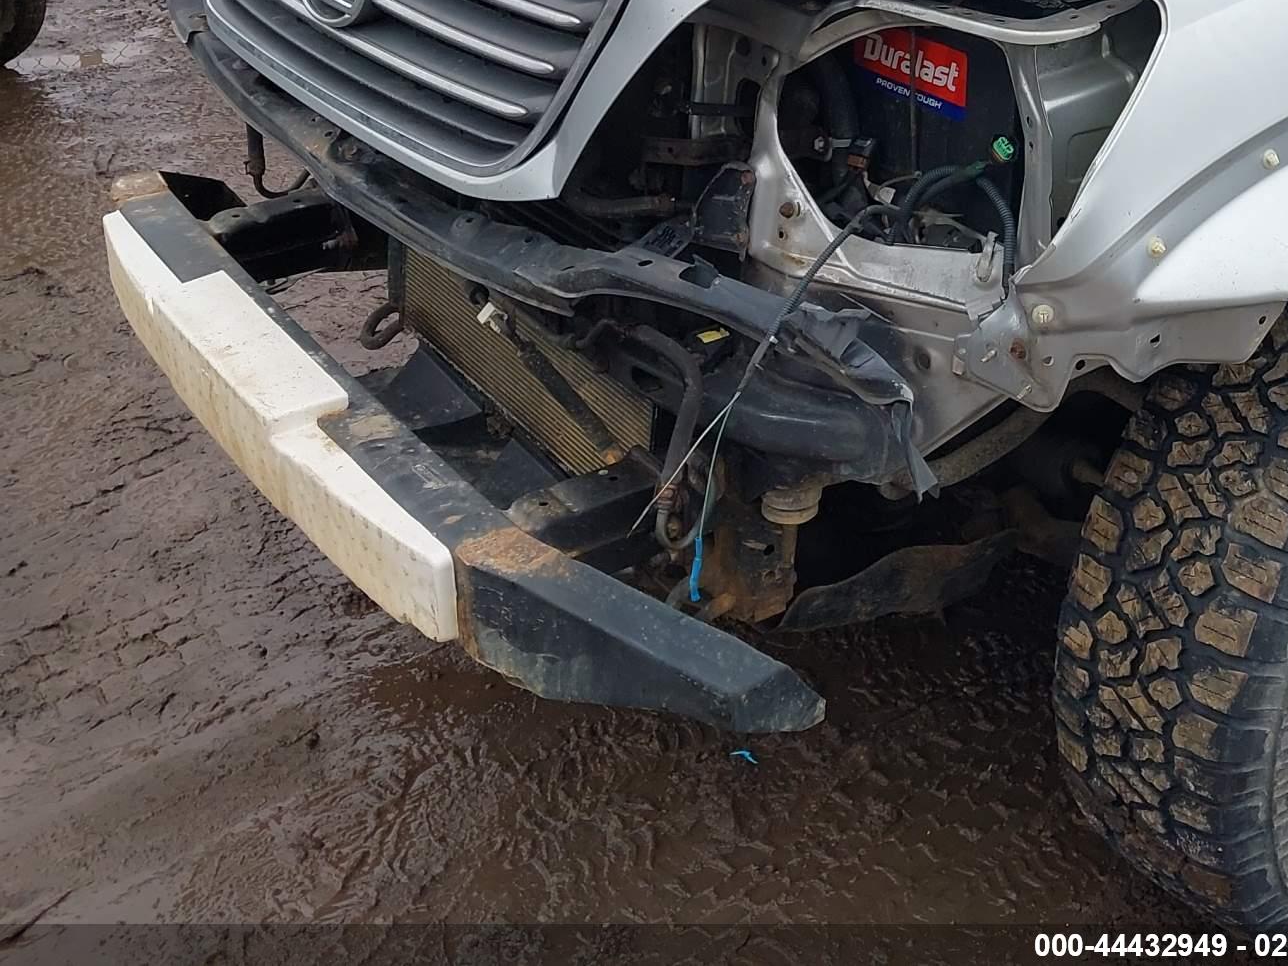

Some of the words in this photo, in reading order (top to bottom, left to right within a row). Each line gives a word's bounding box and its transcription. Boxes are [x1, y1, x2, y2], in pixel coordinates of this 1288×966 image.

[863, 34, 960, 92] Duralast
[875, 77, 911, 97] PROVEN
[914, 92, 943, 109] OUGH
